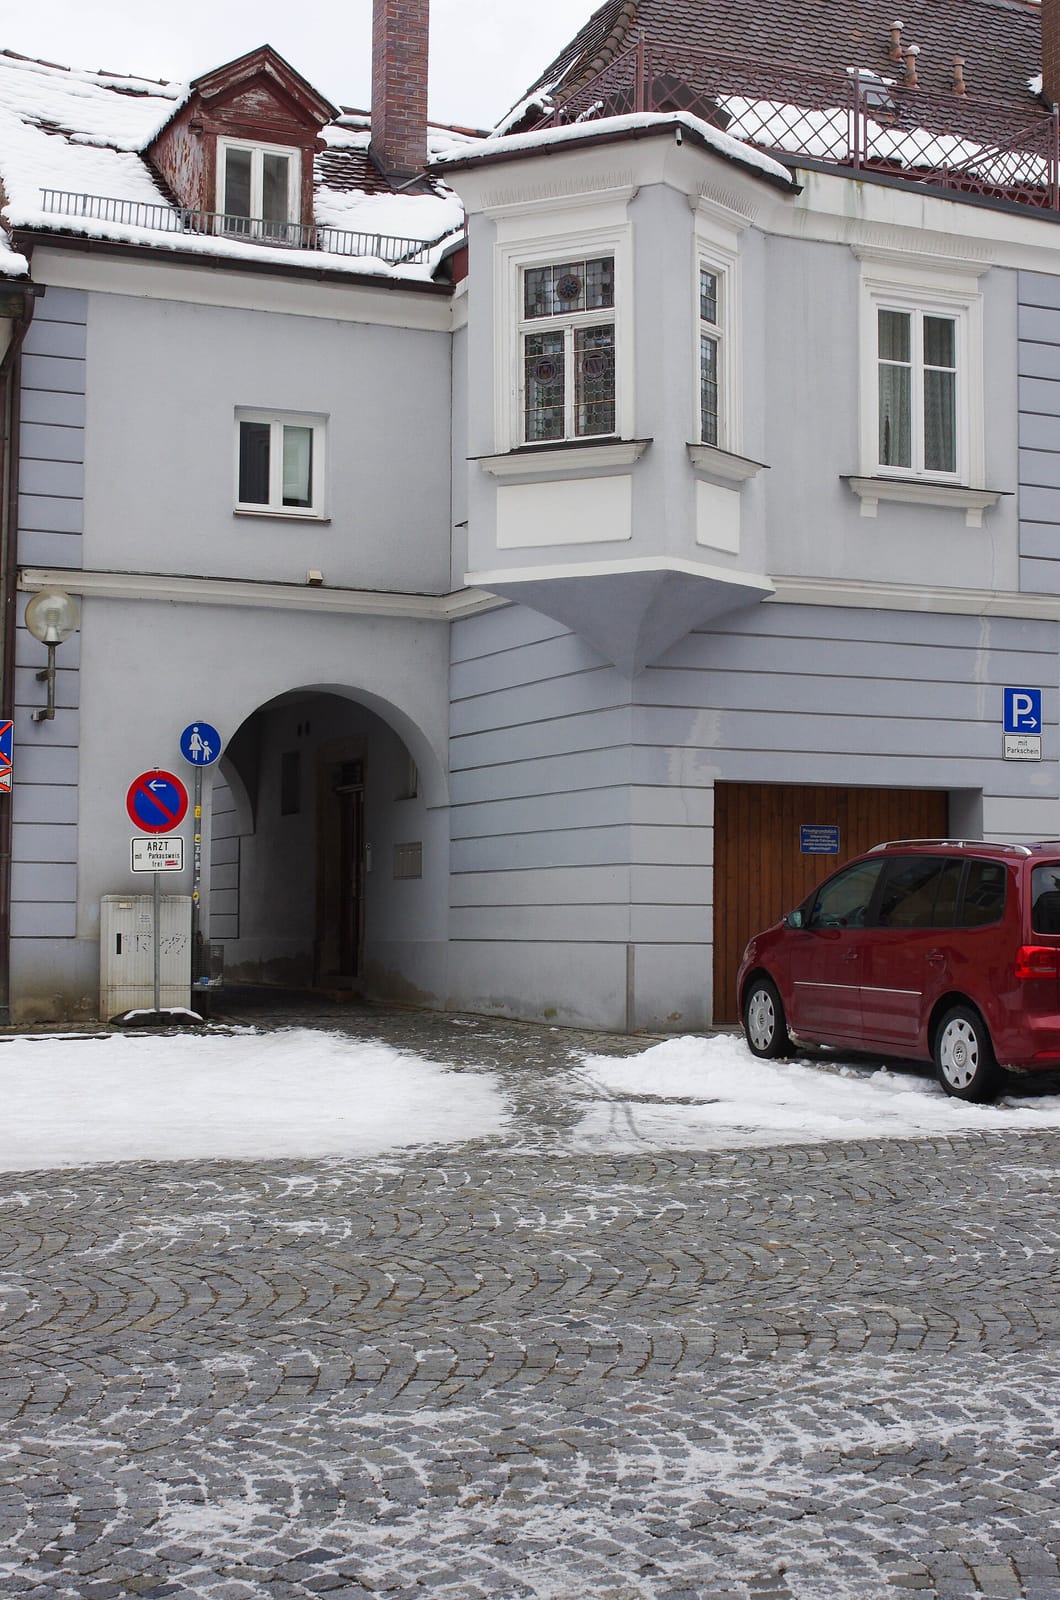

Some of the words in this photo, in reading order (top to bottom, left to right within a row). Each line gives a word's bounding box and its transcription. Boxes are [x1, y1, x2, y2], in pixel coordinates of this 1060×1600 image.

[1013, 693, 1033, 728] P
[1007, 746, 1039, 755] Parkschein
[147, 841, 169, 851] ARZT
[149, 852, 180, 860] Parkausweis
